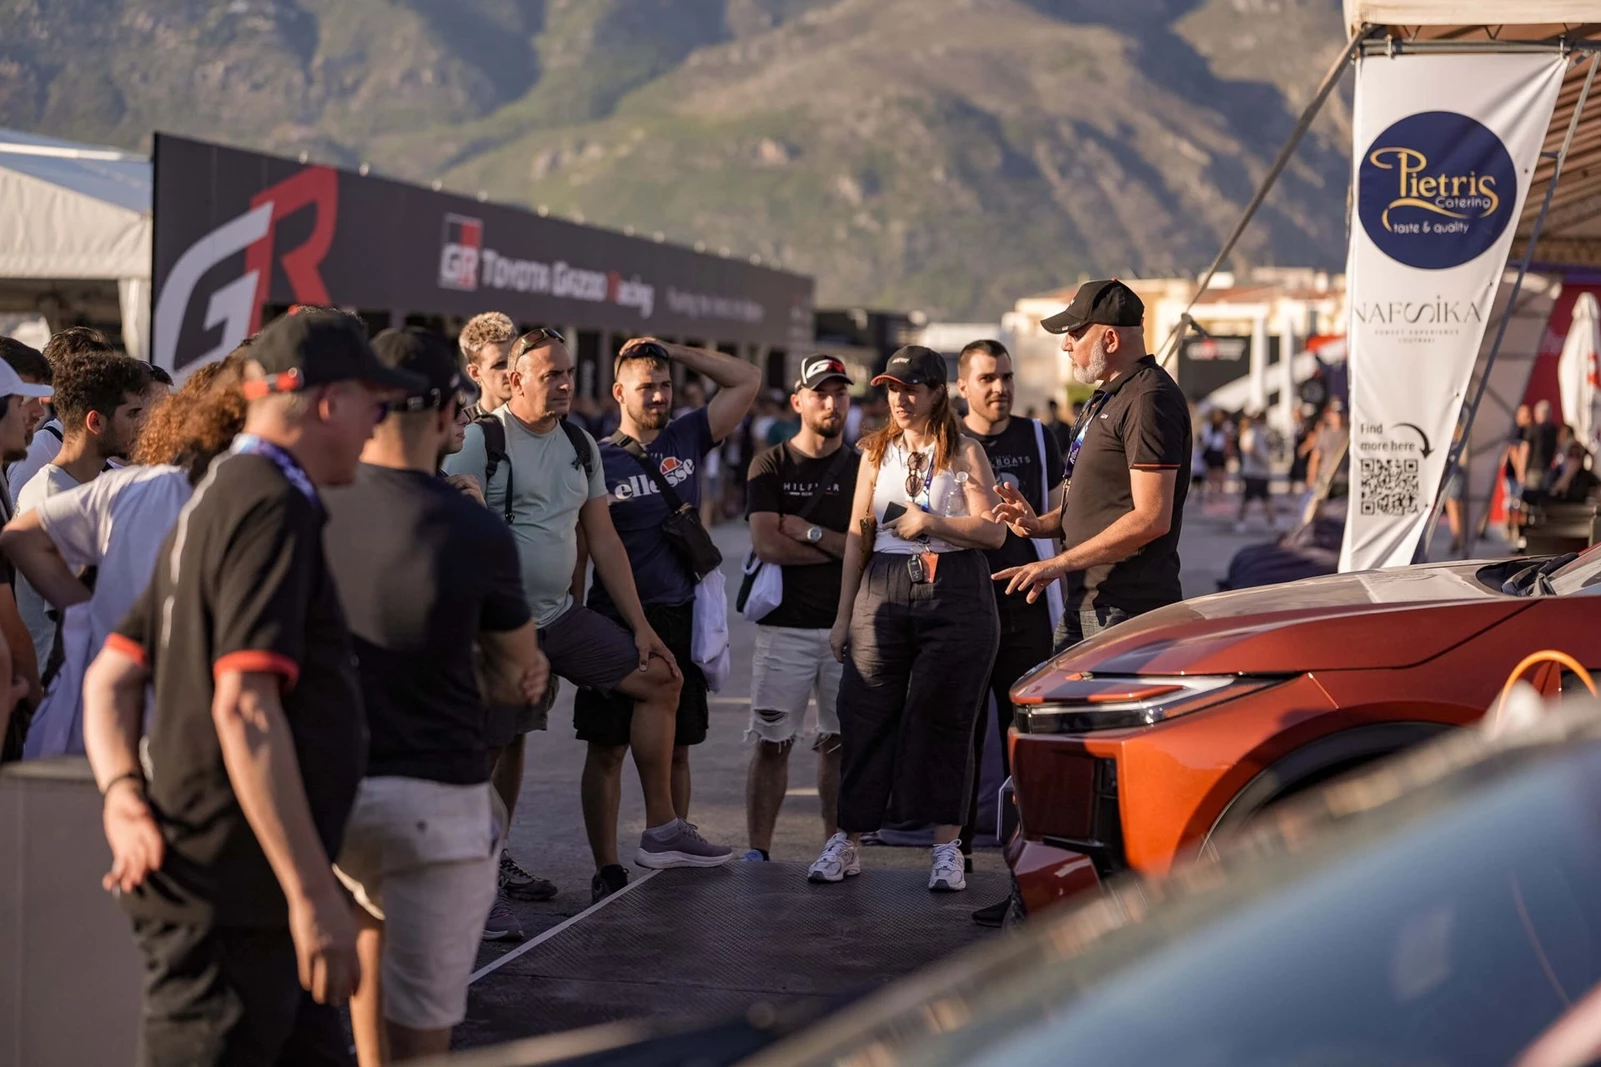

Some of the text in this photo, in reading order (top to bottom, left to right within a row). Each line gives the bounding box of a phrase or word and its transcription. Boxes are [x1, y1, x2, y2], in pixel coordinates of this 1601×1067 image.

[1369, 147, 1499, 218] Pietris
[1435, 196, 1491, 210] Catering
[1394, 220, 1469, 234] taste & quality
[1360, 423, 1383, 434] Find
[1361, 440, 1415, 451] more here
